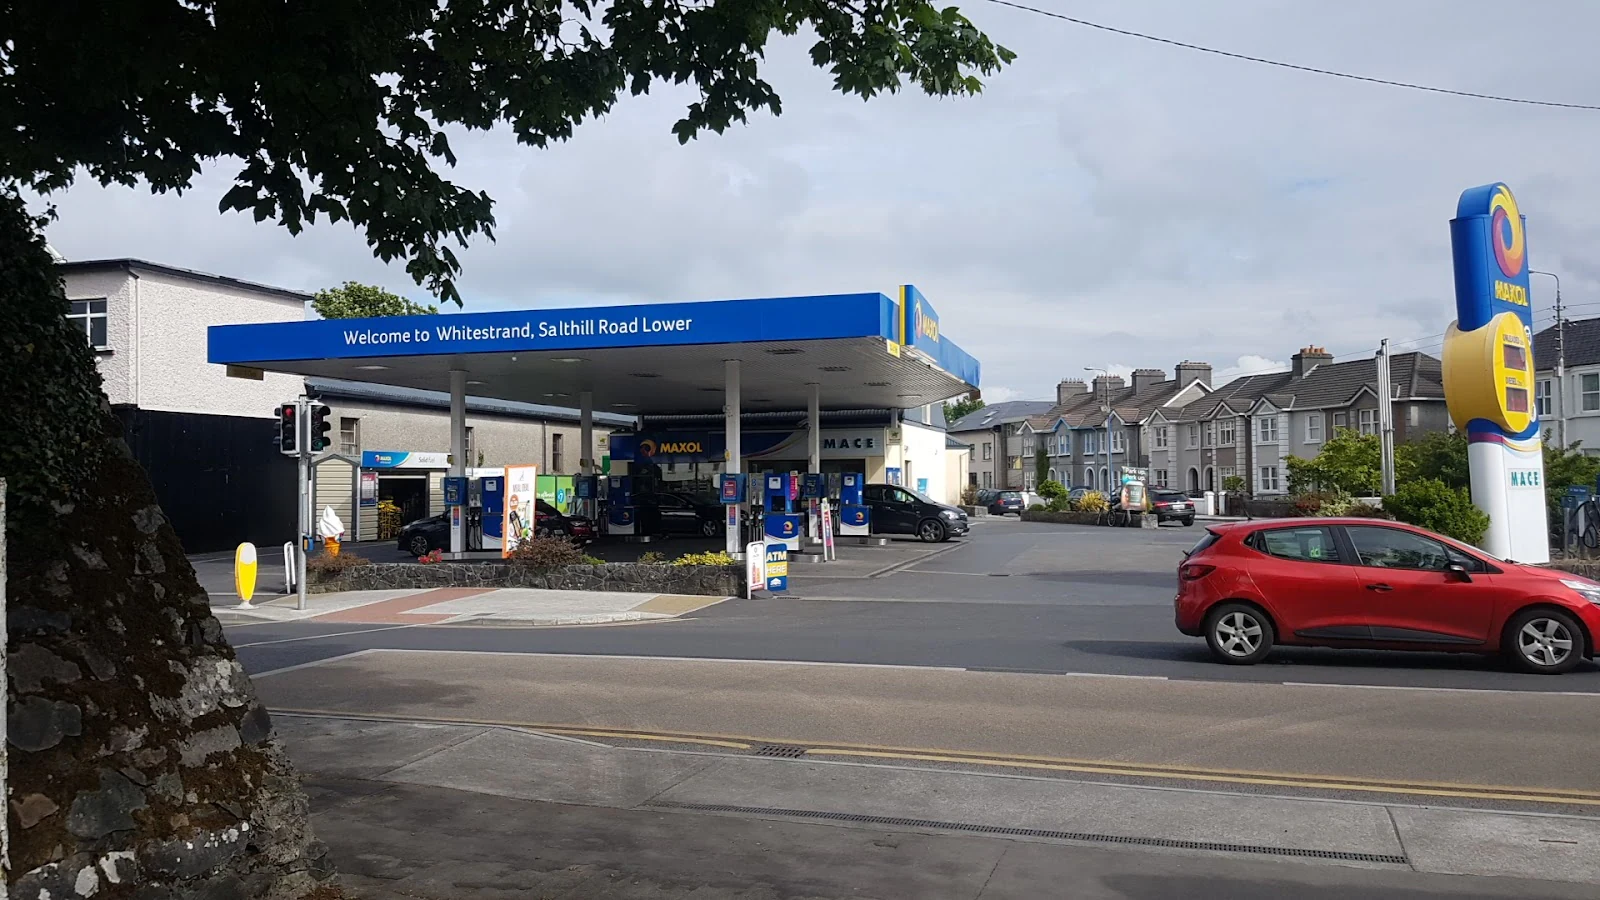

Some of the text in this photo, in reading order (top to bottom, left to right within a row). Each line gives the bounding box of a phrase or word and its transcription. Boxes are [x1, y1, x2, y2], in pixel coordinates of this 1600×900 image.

[1495, 280, 1528, 307] MAXOL
[344, 317, 693, 345] Welcome to Whitestrand, Salthill Road Lower
[660, 442, 703, 453] MAXOL
[823, 438, 874, 449] MACE
[1511, 471, 1539, 486] MACE
[767, 551, 787, 561] ATM
[767, 565, 786, 575] HERE
